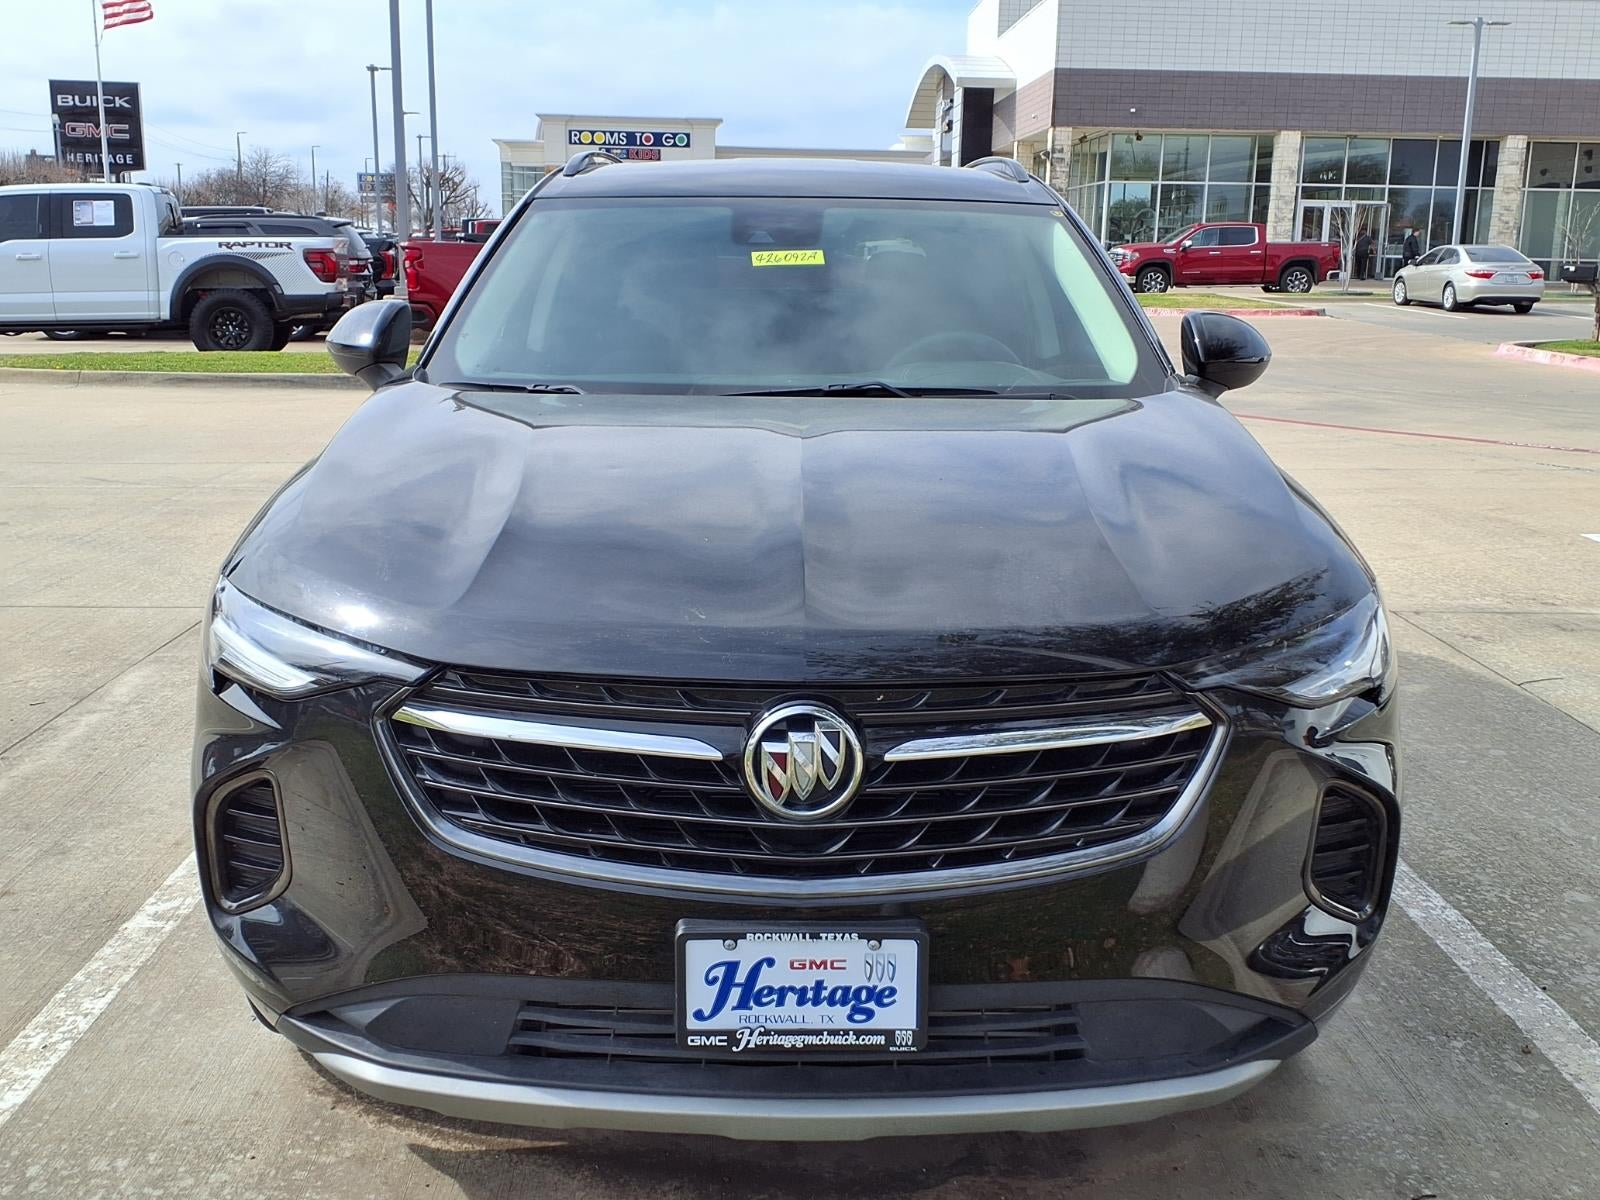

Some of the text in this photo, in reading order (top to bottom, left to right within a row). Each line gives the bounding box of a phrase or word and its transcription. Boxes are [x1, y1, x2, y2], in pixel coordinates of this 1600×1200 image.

[57, 94, 132, 108] BUICK
[65, 122, 129, 139] GMC
[571, 131, 688, 147] ROOMS TO GO
[628, 148, 660, 160] KIDS
[218, 241, 294, 251] RAPTOR
[755, 251, 818, 264] 426092A
[746, 932, 859, 943] ROCKWALL, TEXAS
[789, 958, 847, 971] GMC
[692, 956, 897, 1024] Heritage
[739, 1014, 834, 1025] ROCKWALL, TX
[687, 1026, 886, 1052] GMC Heritagegmcbuick.com
